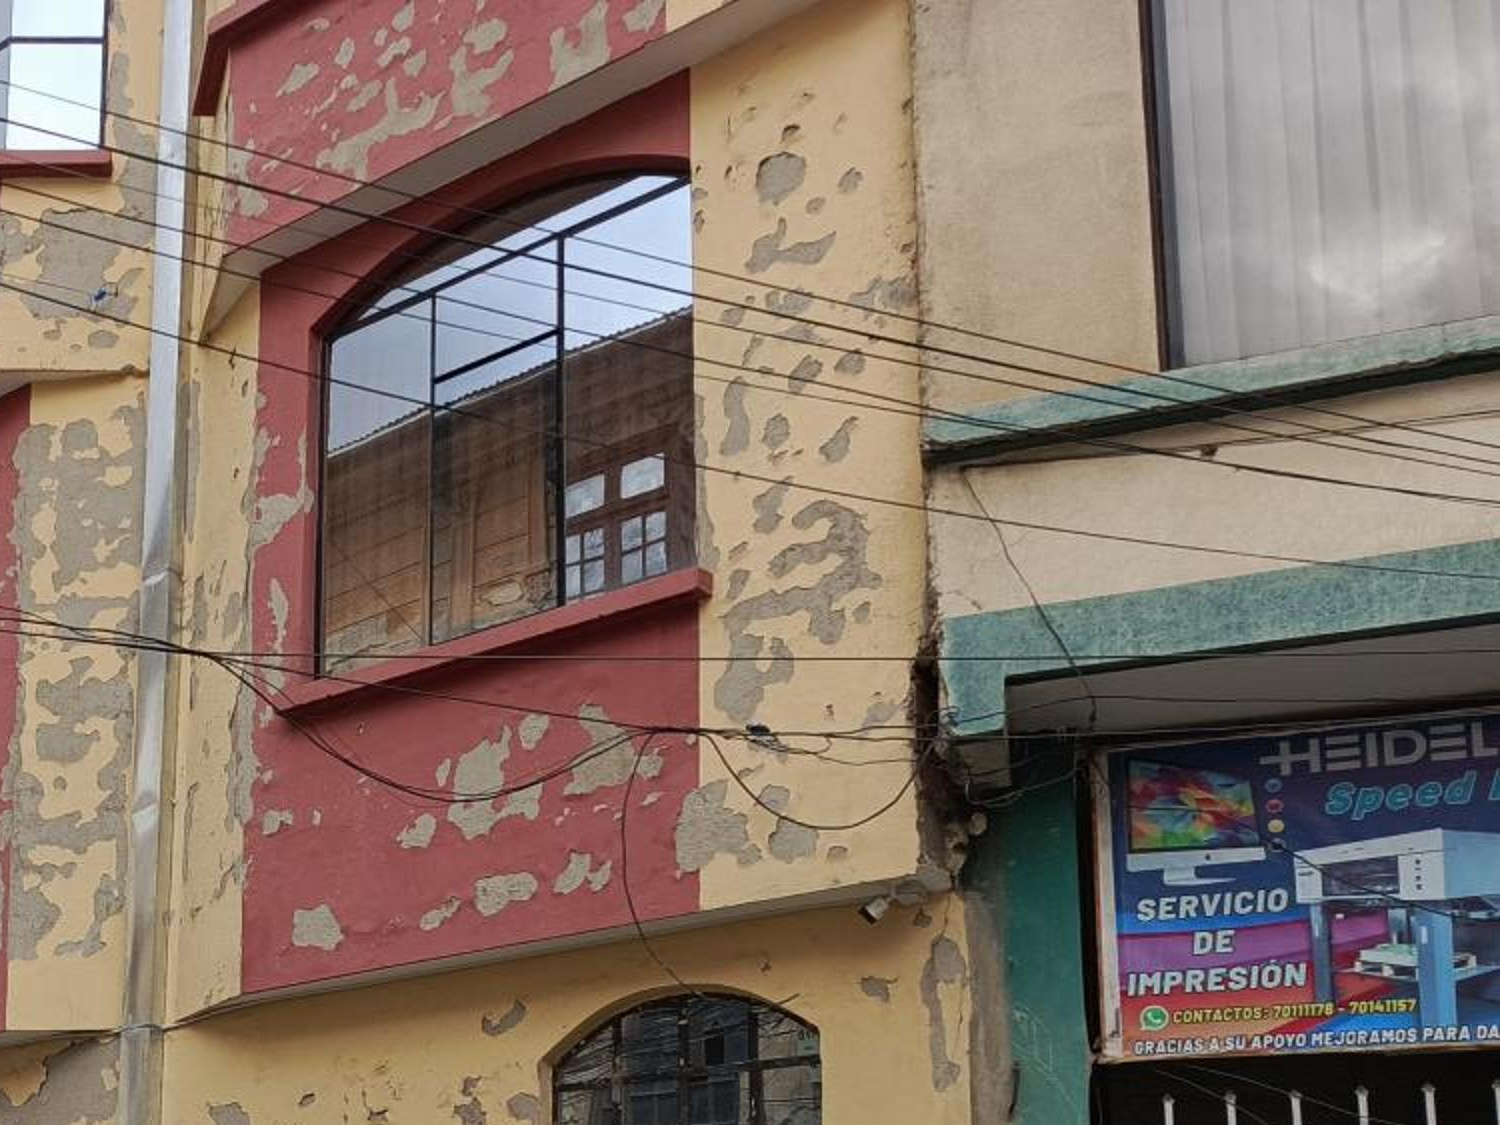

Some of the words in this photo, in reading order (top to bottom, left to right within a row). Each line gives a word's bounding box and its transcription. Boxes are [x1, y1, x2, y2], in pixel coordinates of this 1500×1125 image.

[1325, 769, 1478, 821] Speed
[1136, 887, 1289, 922] SERVICIO
[1192, 929, 1236, 955] DE
[1127, 959, 1307, 997] IMPRESIÓN
[1173, 1006, 1270, 1024] CONTACTOS:
[1349, 999, 1417, 1015] 70141157
[1134, 1038, 1204, 1055] GRACIAS
[1209, 1037, 1220, 1050] A
[1225, 1035, 1246, 1050] SU
[1251, 1033, 1307, 1048] APOYO
[1311, 1027, 1418, 1046] MEJORAMOS
[1423, 1025, 1471, 1041] PARA
